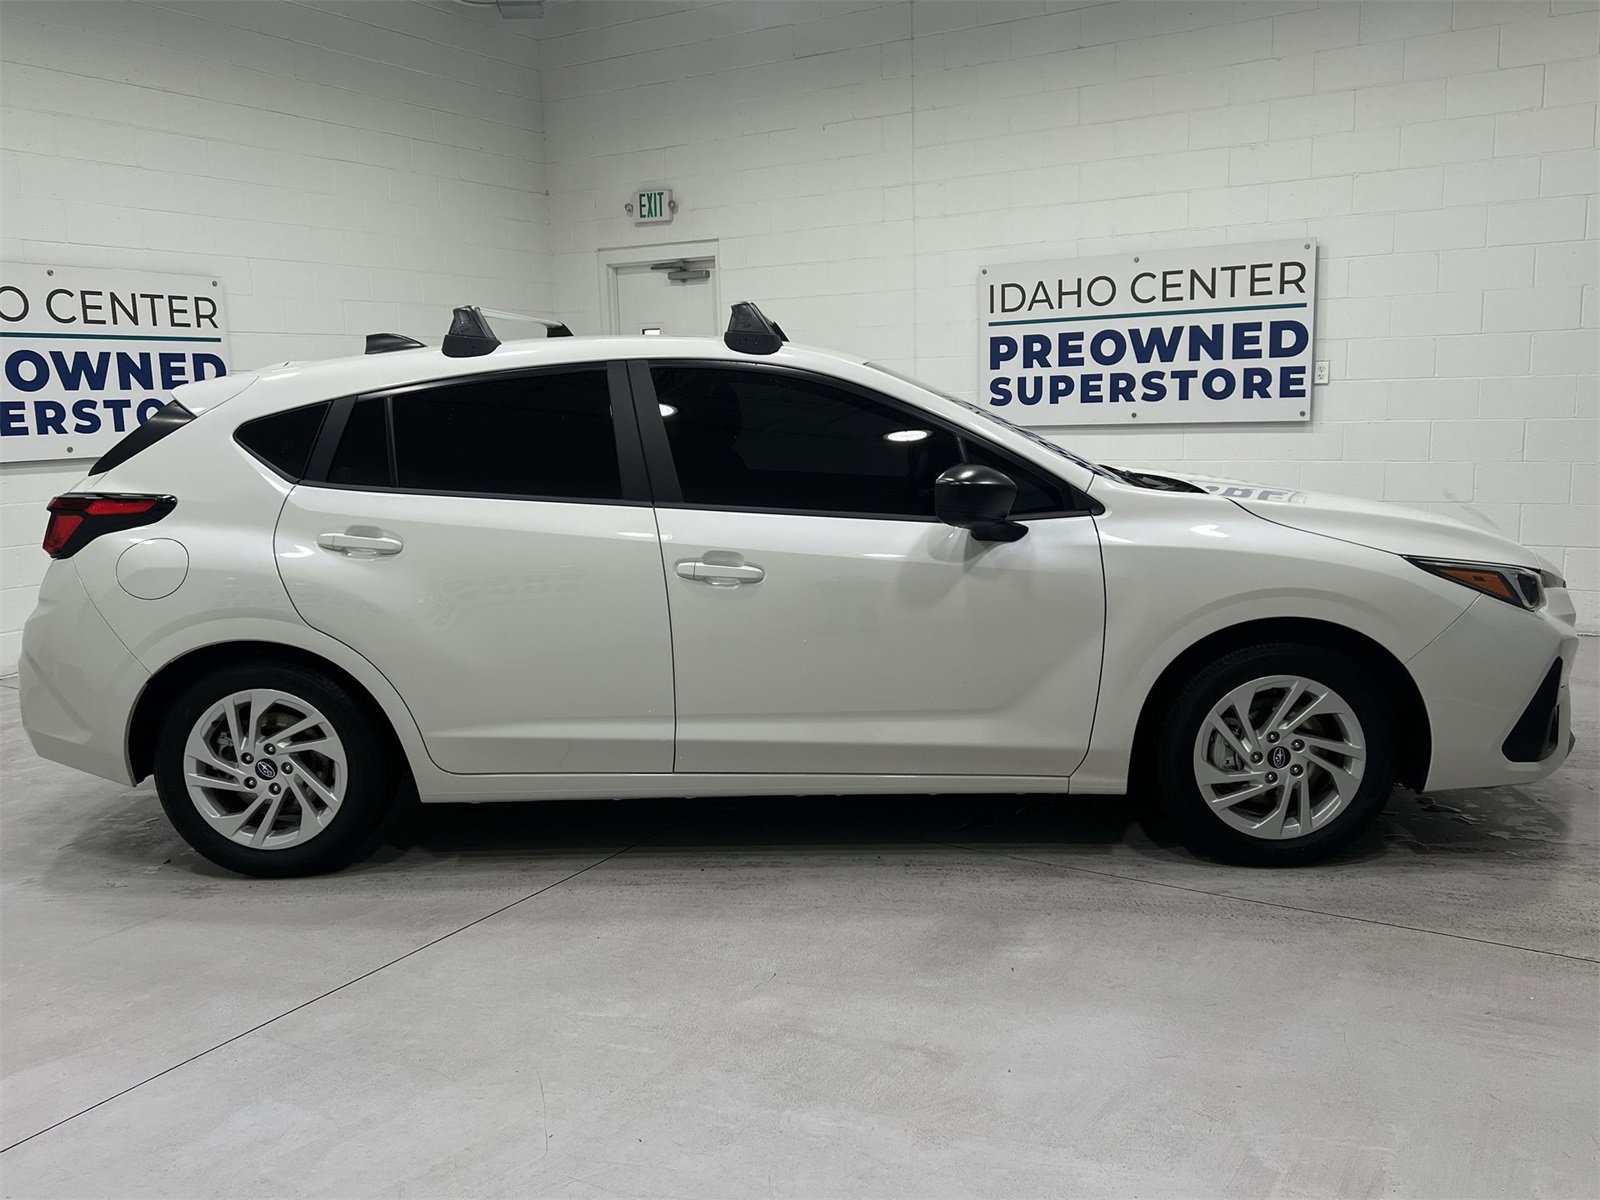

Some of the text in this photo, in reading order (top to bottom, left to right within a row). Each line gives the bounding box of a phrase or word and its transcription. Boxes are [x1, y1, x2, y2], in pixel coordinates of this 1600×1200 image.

[639, 191, 665, 219] EXIT
[45, 288, 219, 329] CENTER
[988, 261, 1307, 314] IDAHO CENTER
[989, 319, 1309, 371] PREOWNED
[4, 349, 227, 392] OWNED
[989, 365, 1307, 407] SUPERSTORE
